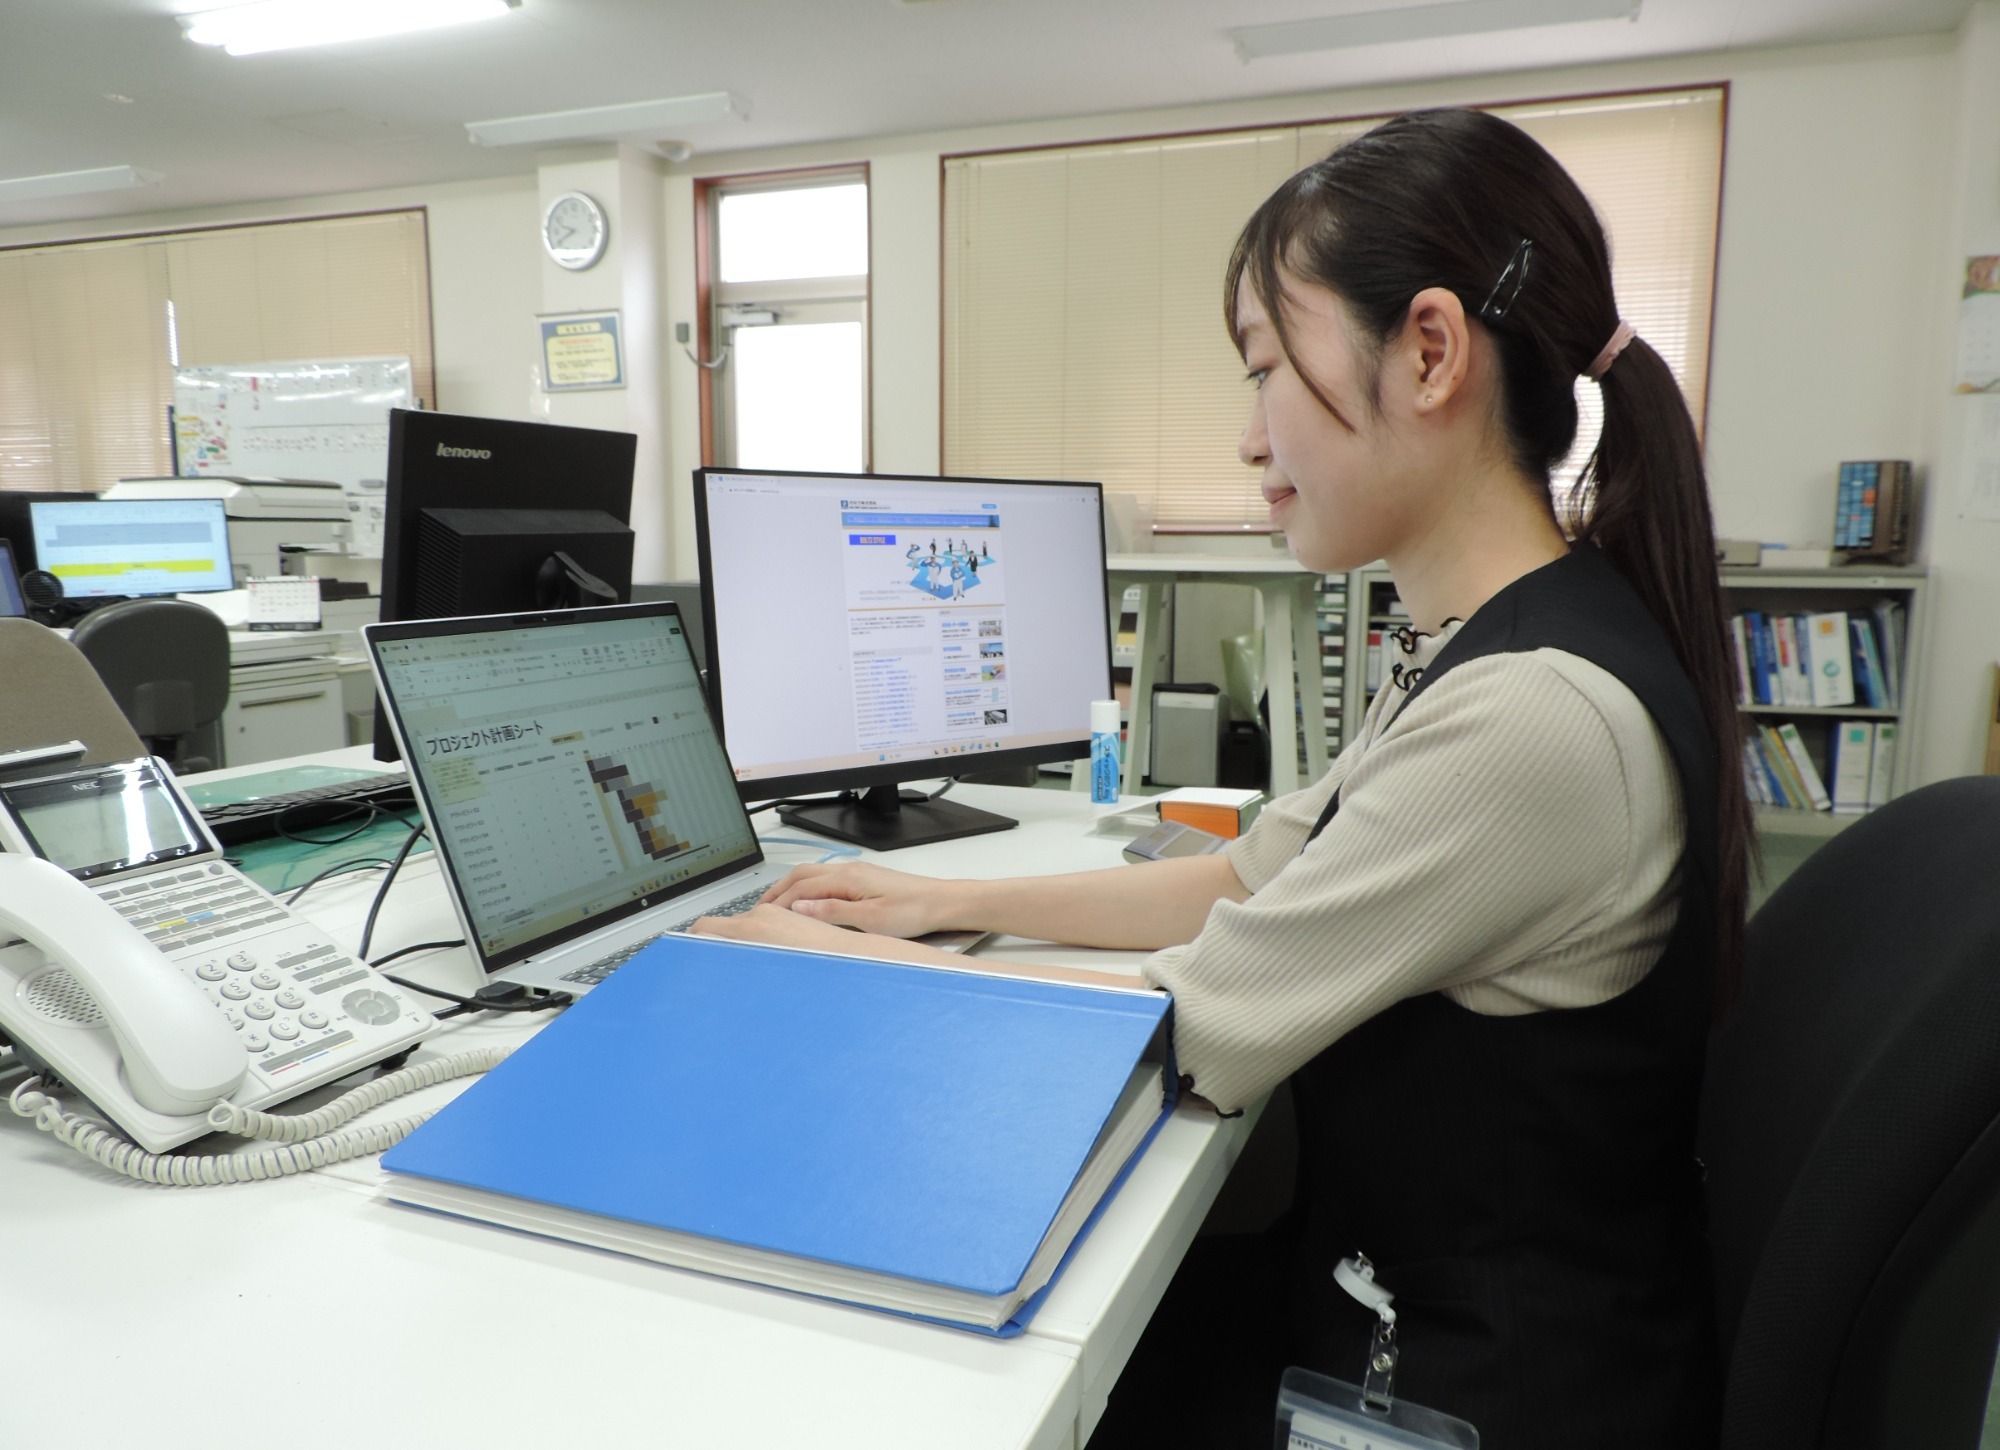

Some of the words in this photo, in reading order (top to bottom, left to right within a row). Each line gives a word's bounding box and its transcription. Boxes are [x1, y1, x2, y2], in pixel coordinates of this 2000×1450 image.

[436, 442, 492, 460] lenovo
[426, 720, 543, 756] プロジェクト計画シート
[71, 780, 101, 792] NEC
[235, 954, 247, 963] 3
[205, 964, 217, 973] 2
[259, 972, 270, 981] 6
[229, 982, 241, 991] 5
[283, 991, 295, 1000] 9
[252, 1002, 265, 1011] 8
